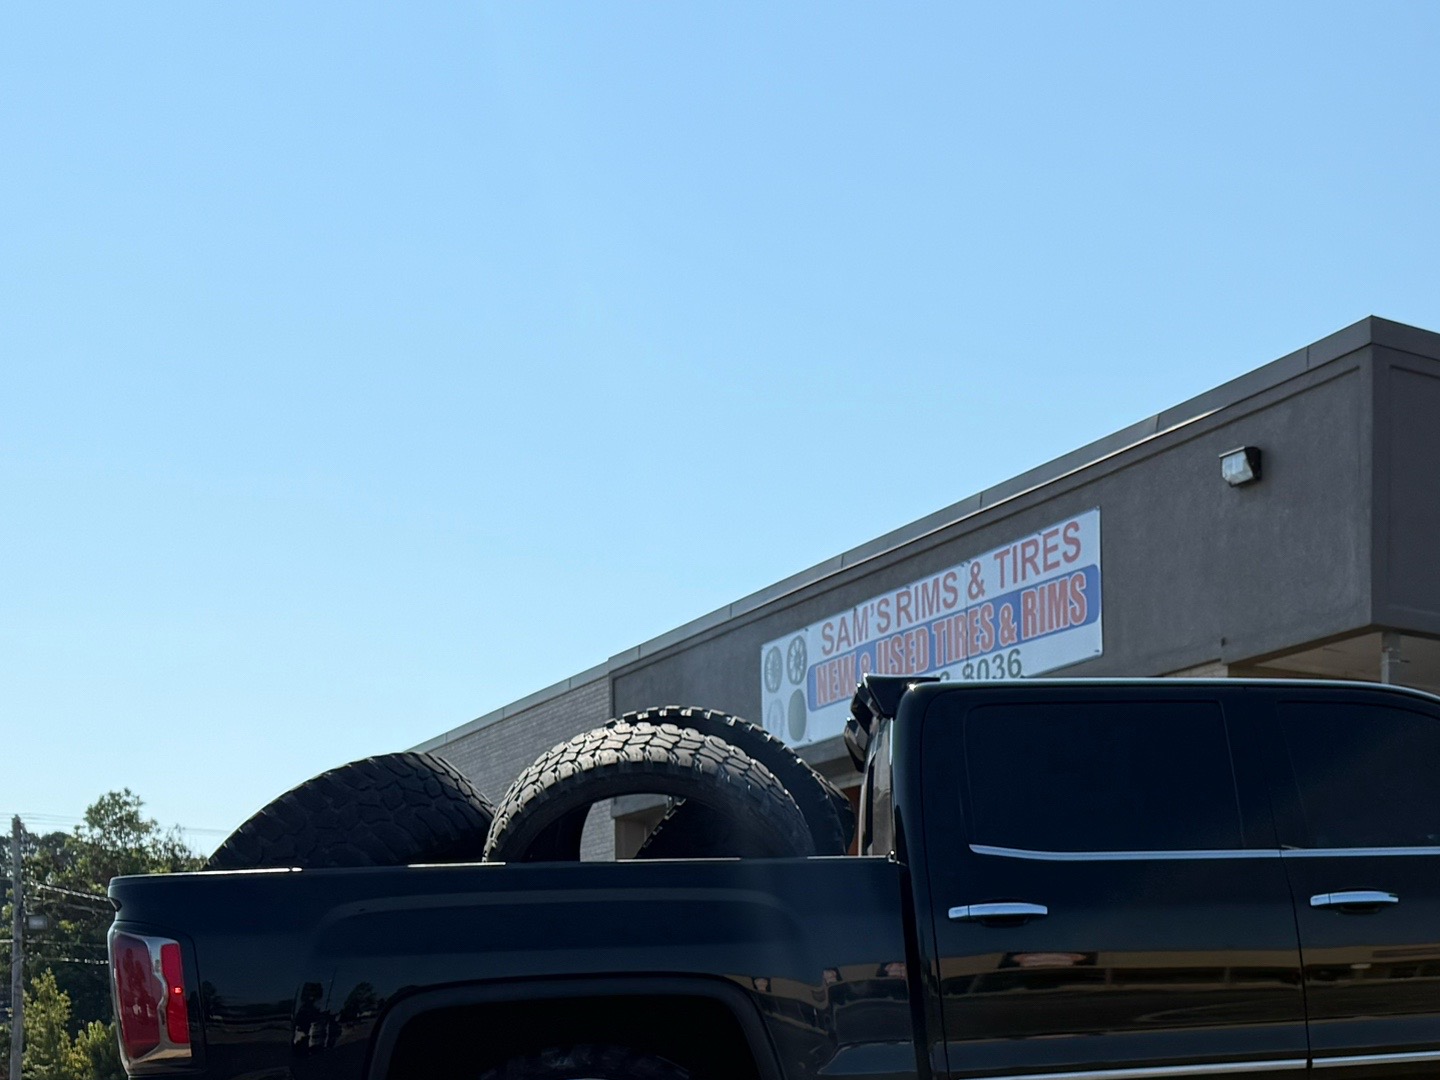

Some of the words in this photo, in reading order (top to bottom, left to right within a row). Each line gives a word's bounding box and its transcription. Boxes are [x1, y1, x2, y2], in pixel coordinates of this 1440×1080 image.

[895, 571, 959, 628] RIMS
[967, 561, 986, 600] &
[993, 520, 1082, 589] TIRES
[815, 654, 858, 704] NEW
[876, 625, 930, 675] USED
[933, 601, 995, 668] TIRES
[1000, 602, 1018, 647] &
[1021, 571, 1088, 640] RIMS
